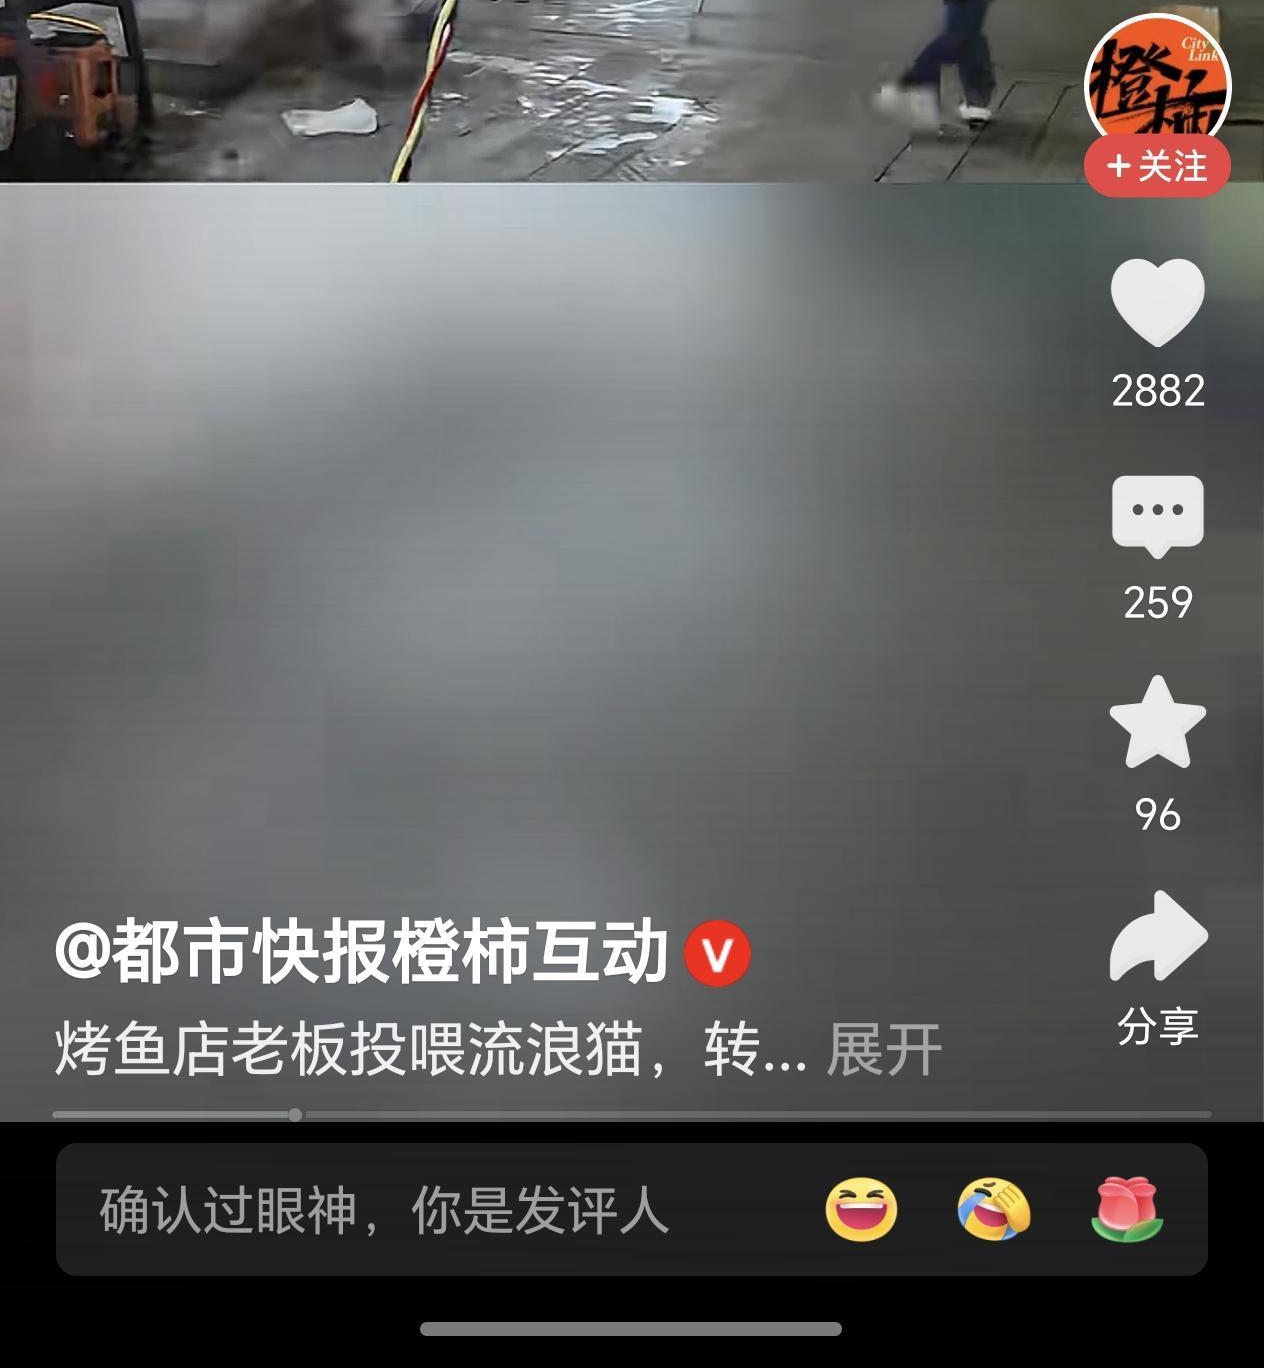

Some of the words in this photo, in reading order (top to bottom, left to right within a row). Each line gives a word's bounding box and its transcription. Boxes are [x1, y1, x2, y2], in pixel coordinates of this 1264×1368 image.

[1181, 35, 1211, 53] City
[1188, 46, 1219, 62] Link
[1138, 148, 1208, 183] 关注
[1112, 373, 1205, 407] 2882
[1124, 585, 1193, 619] 259
[1135, 797, 1181, 831] 96
[55, 916, 669, 985] @都市快报橙柿互动
[1117, 1005, 1200, 1049] 分享
[826, 1022, 943, 1079] 展开
[99, 1184, 670, 1237] 确认过眼神，你是发评人
